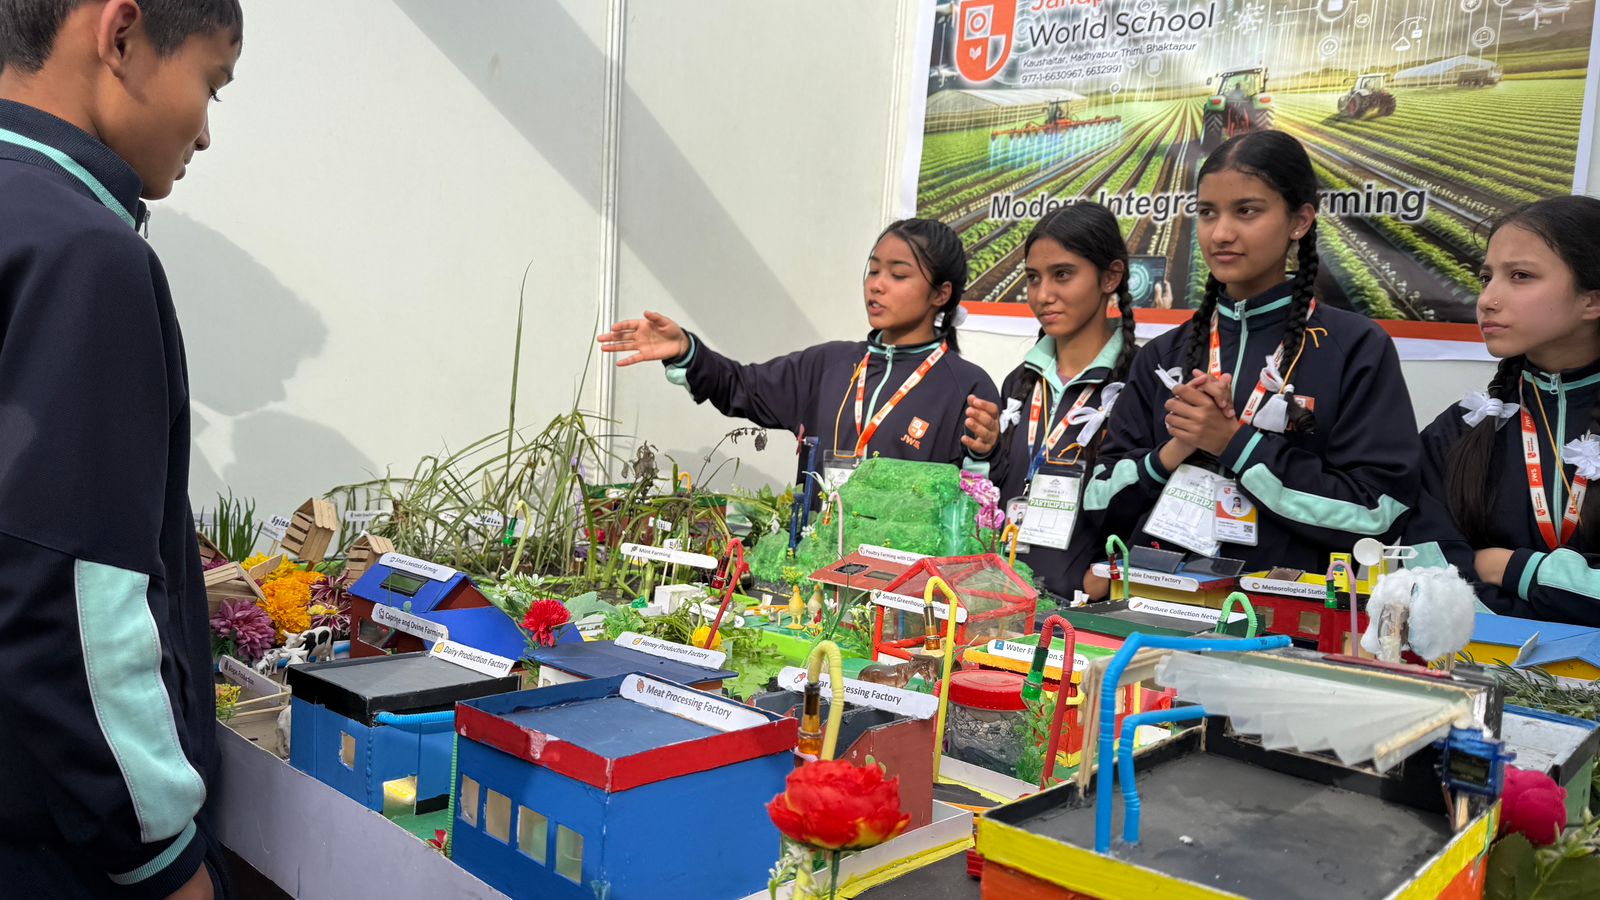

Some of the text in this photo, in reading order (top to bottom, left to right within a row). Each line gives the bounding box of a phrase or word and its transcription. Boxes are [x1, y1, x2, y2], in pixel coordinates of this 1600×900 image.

[1029, 2, 1216, 47] World School
[1070, 50, 1118, 62] Madhyapur
[1146, 42, 1197, 54] Bhaktapur
[900, 434, 921, 449] JWS
[1530, 468, 1538, 482] JWS
[1030, 499, 1076, 511] PARTICIPANT
[423, 565, 438, 574] Farming
[1143, 573, 1161, 582] Energy
[1161, 576, 1182, 585] Factory
[1262, 584, 1307, 594] Meteorological
[882, 594, 897, 602] Smart
[1143, 604, 1169, 613] Produce
[1169, 608, 1200, 618] Collection
[402, 618, 411, 627] and
[641, 639, 709, 660] Honey Production Factory
[1006, 643, 1026, 653] Water
[443, 645, 510, 672] Dairy Production Factory
[646, 684, 732, 719] Meat Processing Factory
[871, 689, 902, 705] Factory
